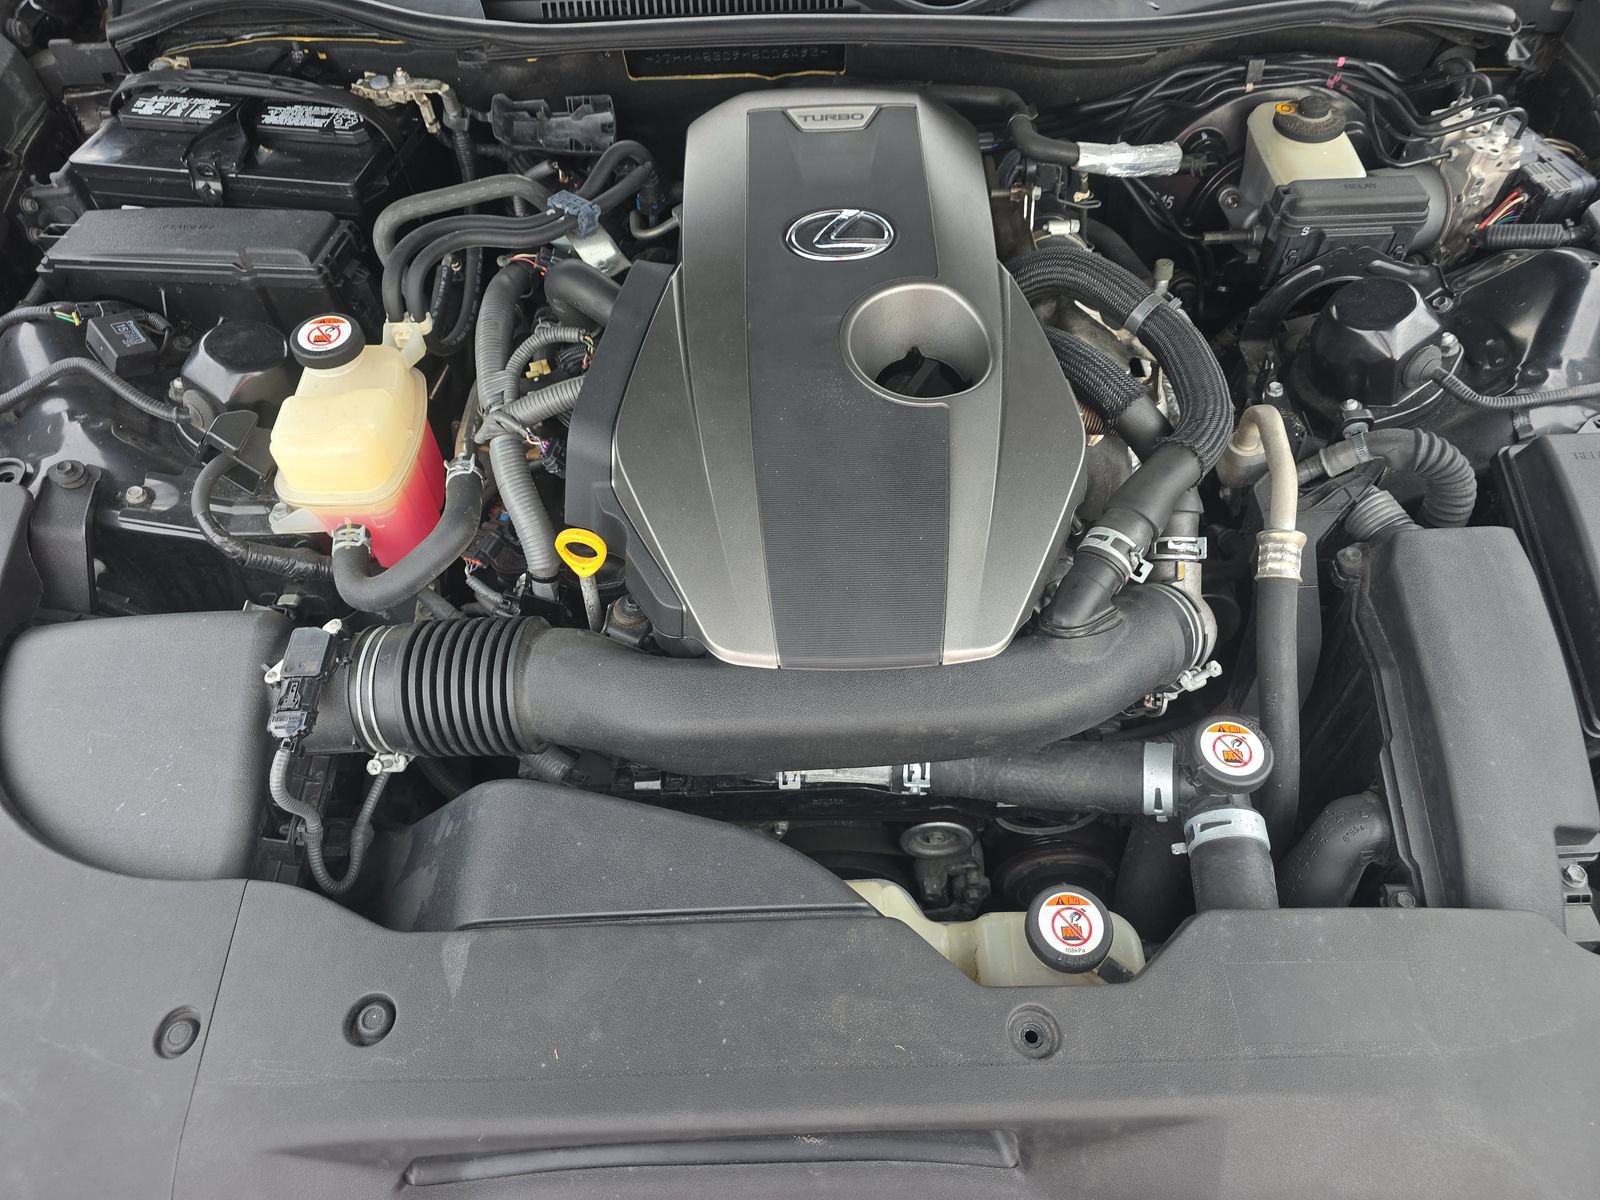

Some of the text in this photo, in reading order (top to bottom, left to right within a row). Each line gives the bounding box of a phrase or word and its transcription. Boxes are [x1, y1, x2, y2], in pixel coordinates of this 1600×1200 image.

[799, 113, 864, 122] TURBO
[1301, 226, 1311, 236] S
[1573, 451, 1600, 460] REL
